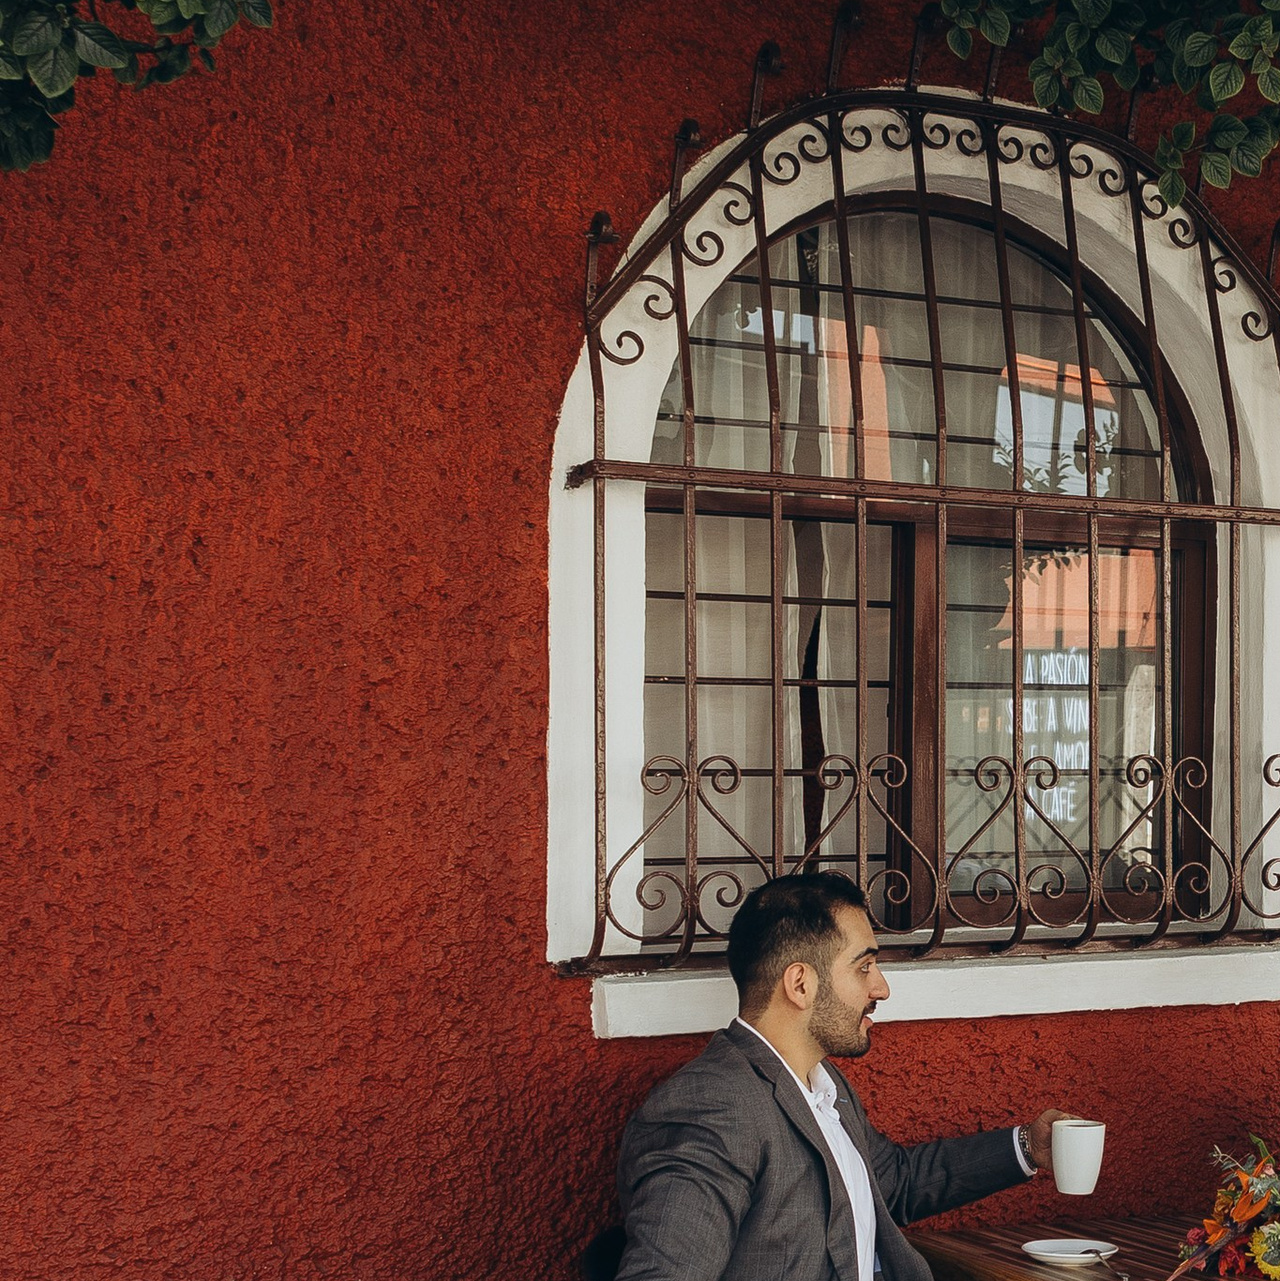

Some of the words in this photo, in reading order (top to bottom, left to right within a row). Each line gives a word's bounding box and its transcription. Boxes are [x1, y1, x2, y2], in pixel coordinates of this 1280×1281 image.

[1041, 647, 1090, 685] PASIÓN
[1007, 697, 1038, 735] SBE
[1047, 696, 1057, 733] A
[1064, 696, 1090, 735] VIN
[1042, 781, 1077, 822] CAFÉ
